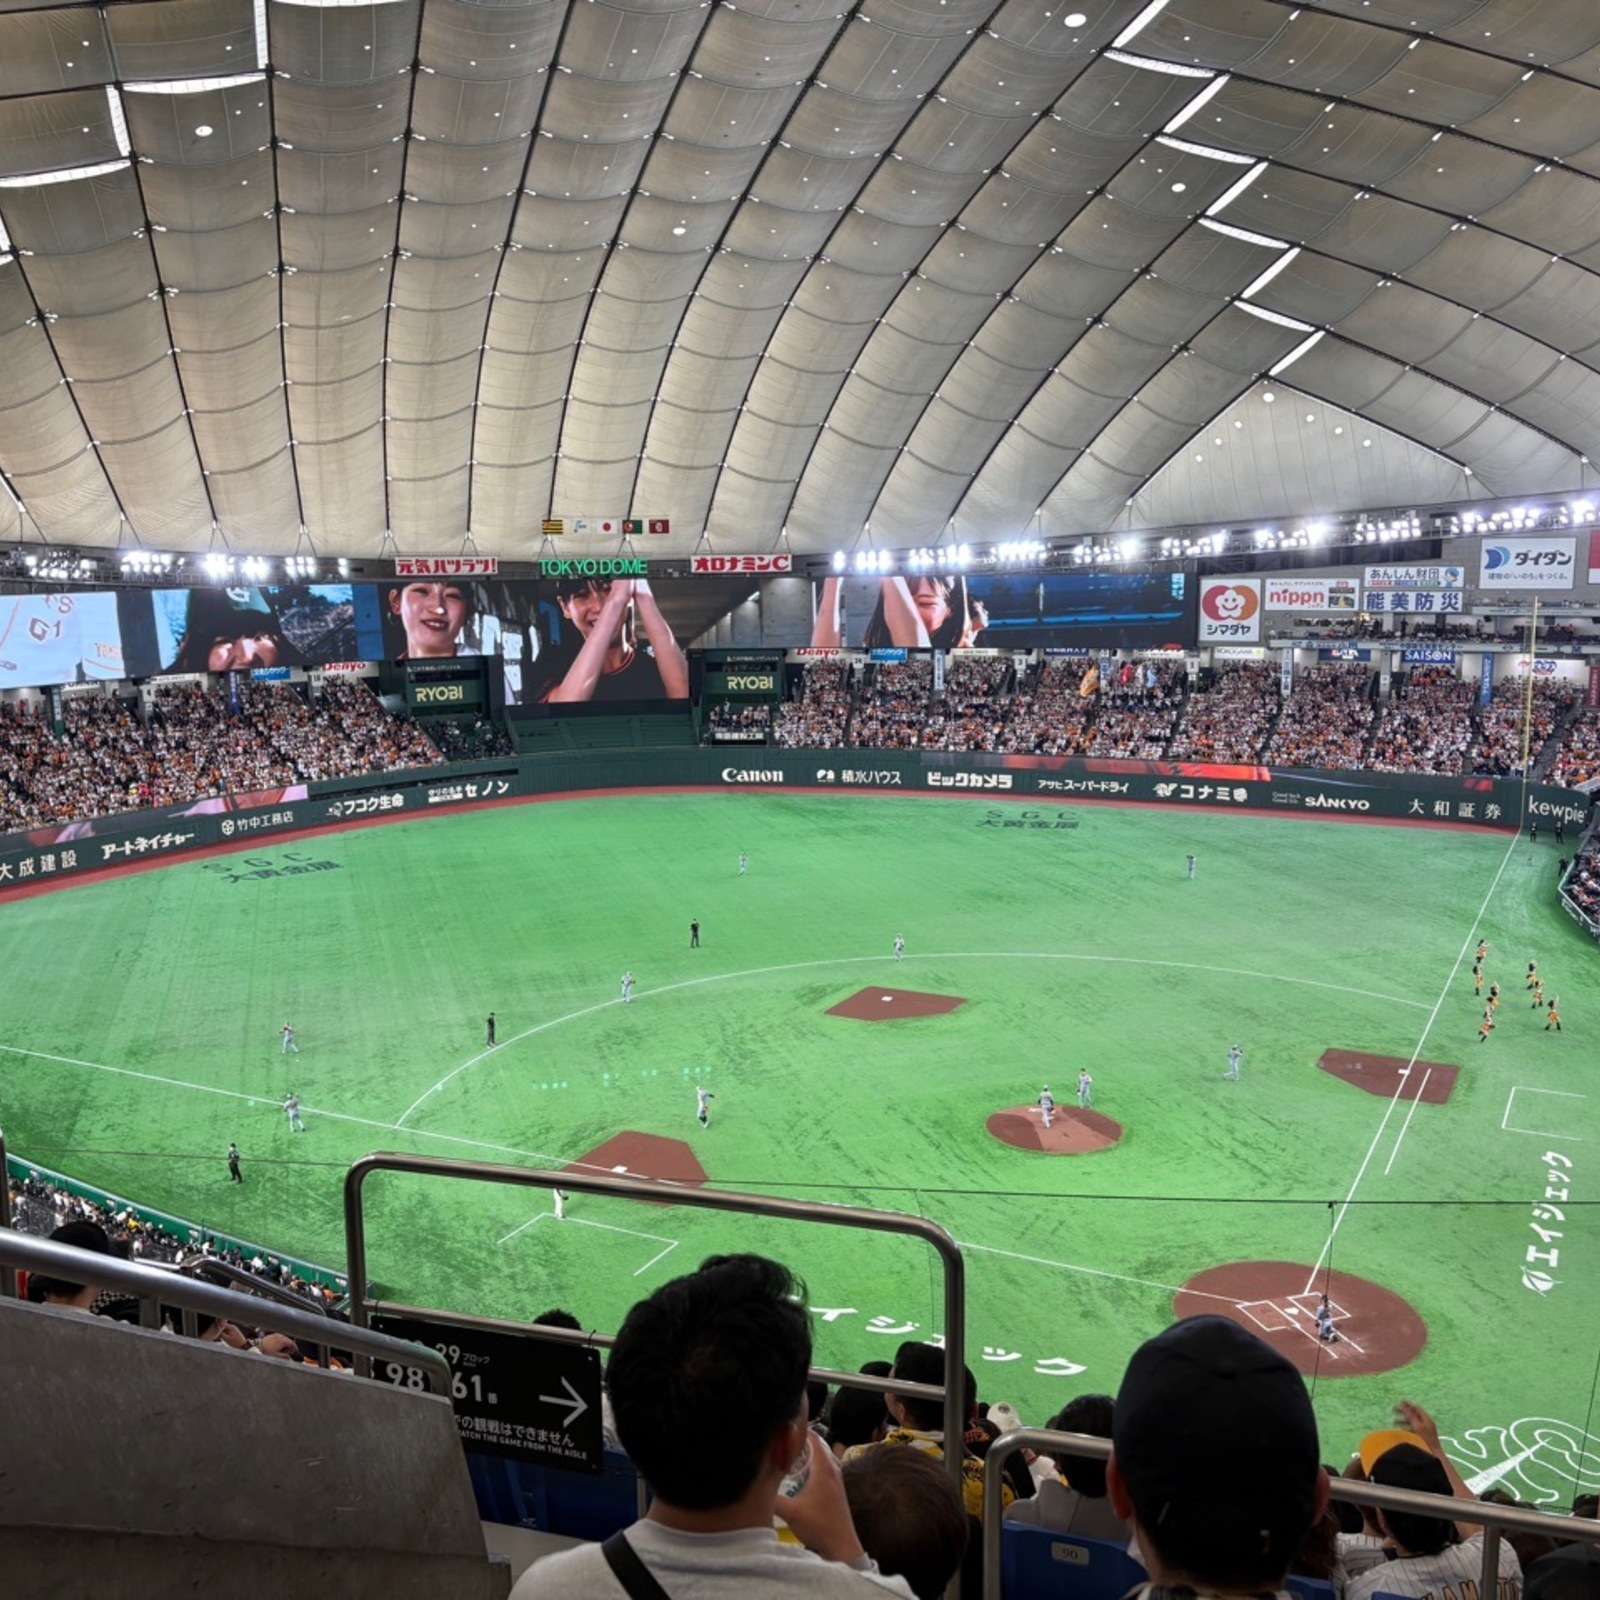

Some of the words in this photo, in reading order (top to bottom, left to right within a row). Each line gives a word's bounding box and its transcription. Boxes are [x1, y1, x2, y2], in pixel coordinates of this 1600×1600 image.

[398, 558, 496, 574] 元気ハツラツ!
[694, 555, 789, 571] オロナミンC
[1514, 549, 1572, 566] ダイダン
[538, 558, 597, 576] TOKYO
[600, 557, 648, 575] DOME
[1370, 567, 1440, 579] あんしん財団
[1269, 588, 1325, 605] nippn
[1366, 592, 1460, 611] 能美防災
[1206, 623, 1251, 635] シマダヤ
[1404, 650, 1452, 661] SAISON
[726, 676, 773, 690] RYOBI
[415, 685, 463, 702] RYOBI
[721, 767, 783, 782] Canon
[841, 769, 902, 785] 積水ハウス
[927, 771, 1013, 789] ビックカメラ
[465, 781, 510, 798] セノン
[1038, 779, 1130, 794] アサヒスーパードライ
[1180, 784, 1230, 801] コナミ
[344, 792, 404, 816] フコク生命
[1304, 793, 1370, 811] SANKYO
[1408, 798, 1501, 820] 大和証券
[1528, 795, 1585, 823] kewpie
[236, 811, 294, 831] 竹中工務店
[101, 833, 195, 860] アートネイチャー
[0, 849, 78, 882] 大成建設
[1526, 1151, 1573, 1268] エイジェック
[386, 1362, 425, 1393] 98
[452, 1371, 482, 1402] 61
[483, 1433, 498, 1443] THE
[500, 1435, 521, 1447] GAME
[523, 1440, 546, 1451] FROM
[547, 1444, 562, 1456] THE
[564, 1448, 588, 1460] AISLE
